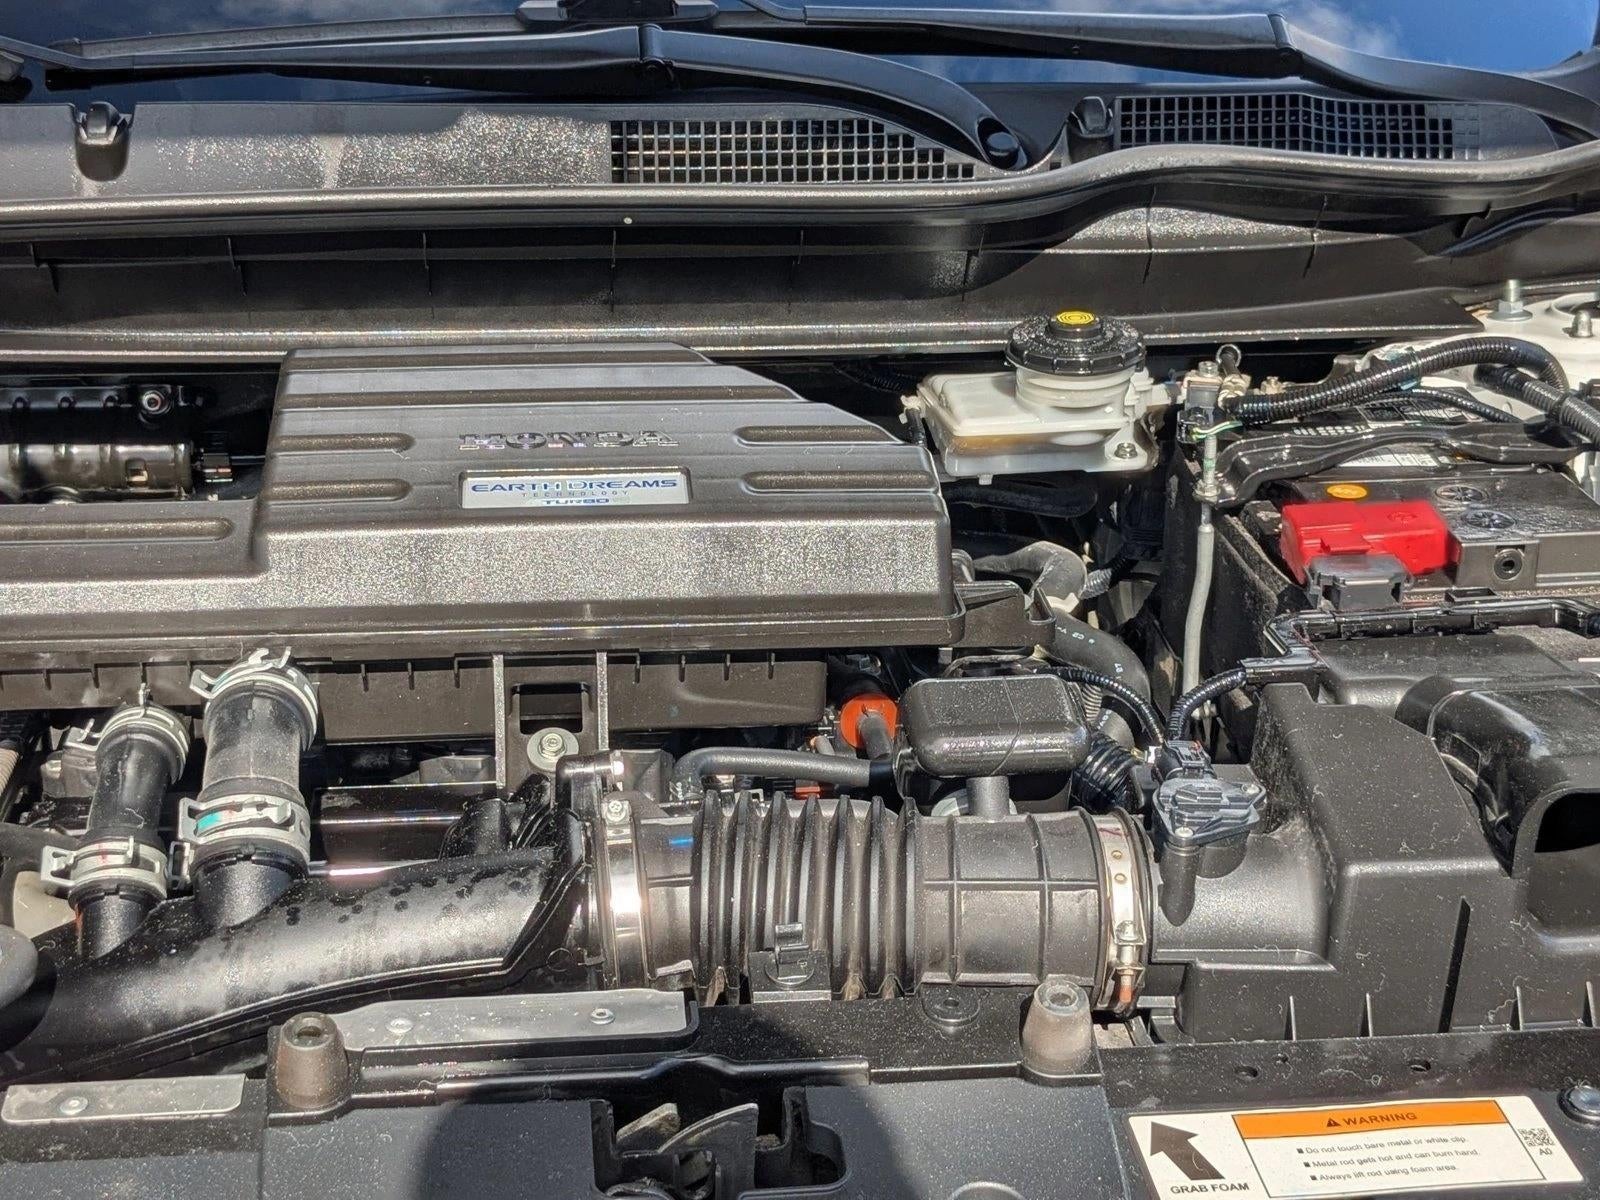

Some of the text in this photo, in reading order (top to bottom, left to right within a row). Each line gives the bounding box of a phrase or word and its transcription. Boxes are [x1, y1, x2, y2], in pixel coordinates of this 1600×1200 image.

[459, 430, 680, 450] HONDA
[471, 479, 677, 492] EARTH DREAMS
[1342, 1112, 1418, 1126] WARNING
[1305, 1146, 1319, 1154] Do
[1321, 1145, 1335, 1153] not
[1337, 1144, 1363, 1152] touch
[1365, 1141, 1385, 1150] bare
[1387, 1139, 1412, 1147] metal
[1425, 1136, 1449, 1145] white
[1312, 1159, 1338, 1167] Metal
[1340, 1158, 1355, 1166] rod
[1357, 1156, 1377, 1166] gets
[1379, 1154, 1393, 1162] hot
[1395, 1152, 1412, 1160] and
[1432, 1150, 1454, 1158] burn
[1320, 1174, 1352, 1182] Always
[1367, 1169, 1382, 1177] rod
[1384, 1166, 1410, 1176] using
[1410, 1165, 1434, 1173] foam
[1170, 1182, 1250, 1194] GRAB FOAM
